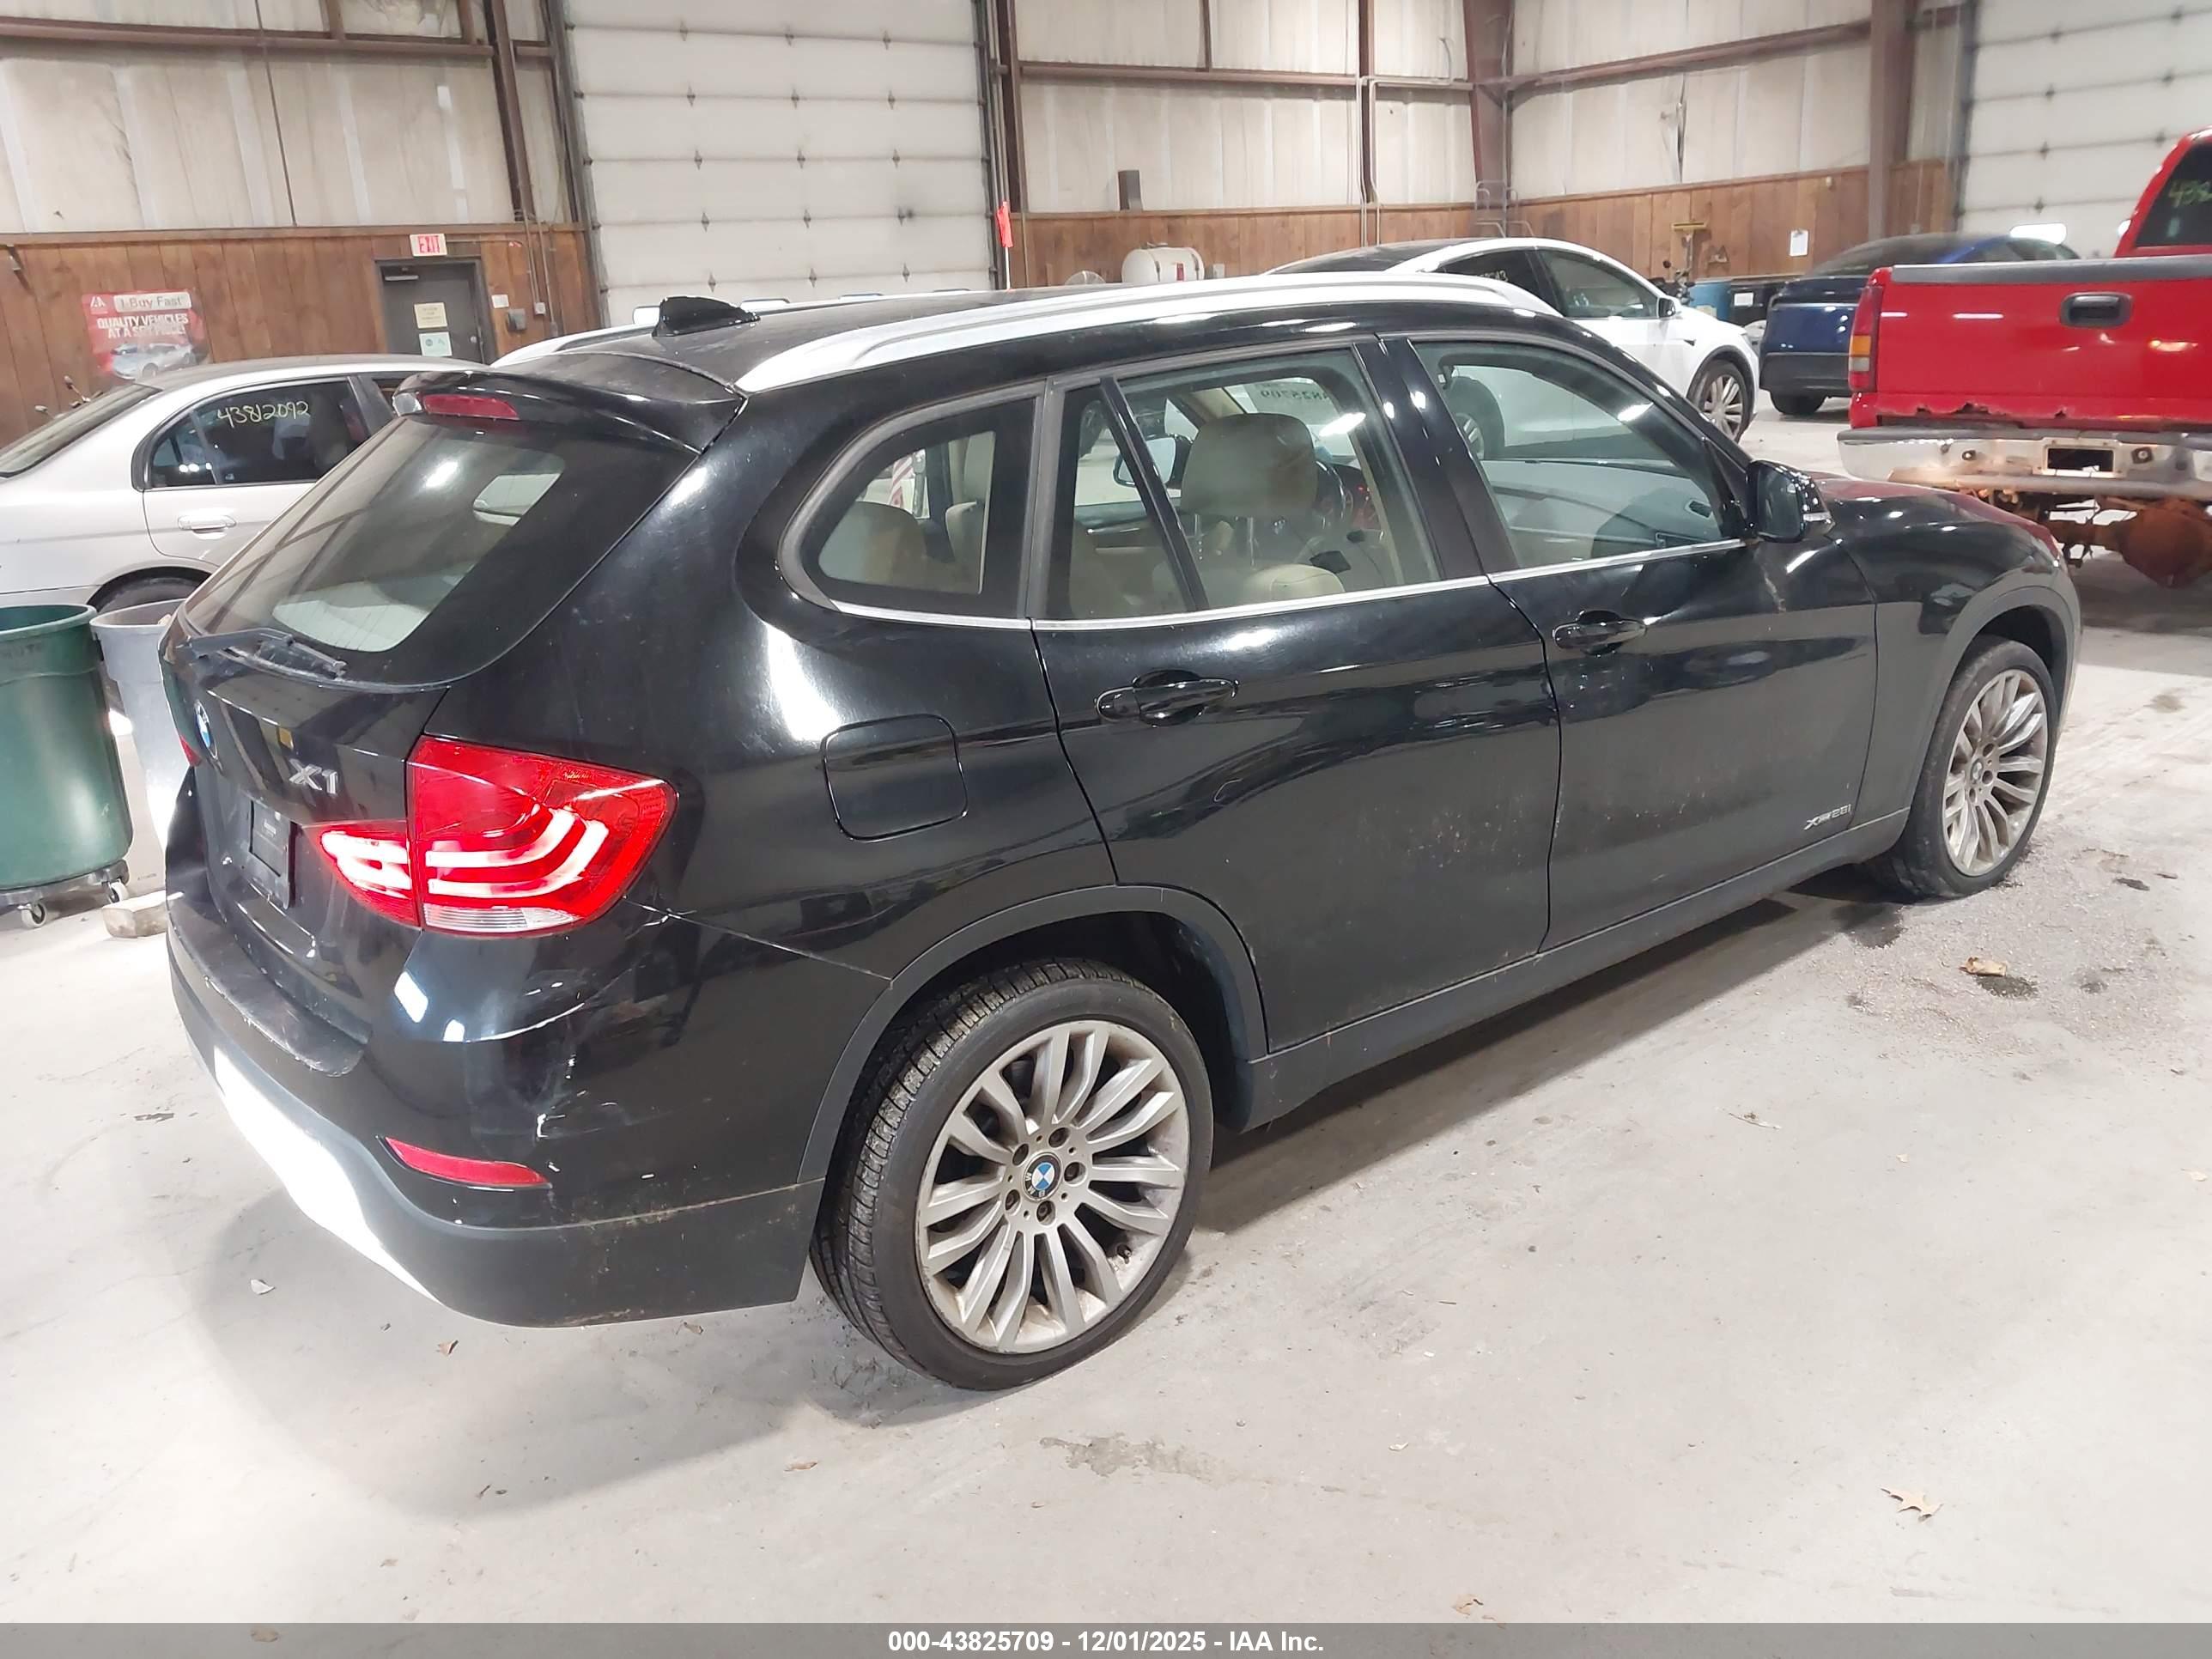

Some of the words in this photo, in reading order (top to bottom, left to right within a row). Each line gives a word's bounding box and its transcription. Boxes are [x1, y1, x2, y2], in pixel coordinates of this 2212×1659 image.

[417, 234, 441, 253] EXIT
[156, 295, 182, 307] Fast
[96, 315, 140, 329] QUALITY
[107, 327, 121, 338] AT
[217, 400, 312, 428] 43812092
[288, 757, 338, 795] X1
[1025, 1170, 1046, 1198] BMW
